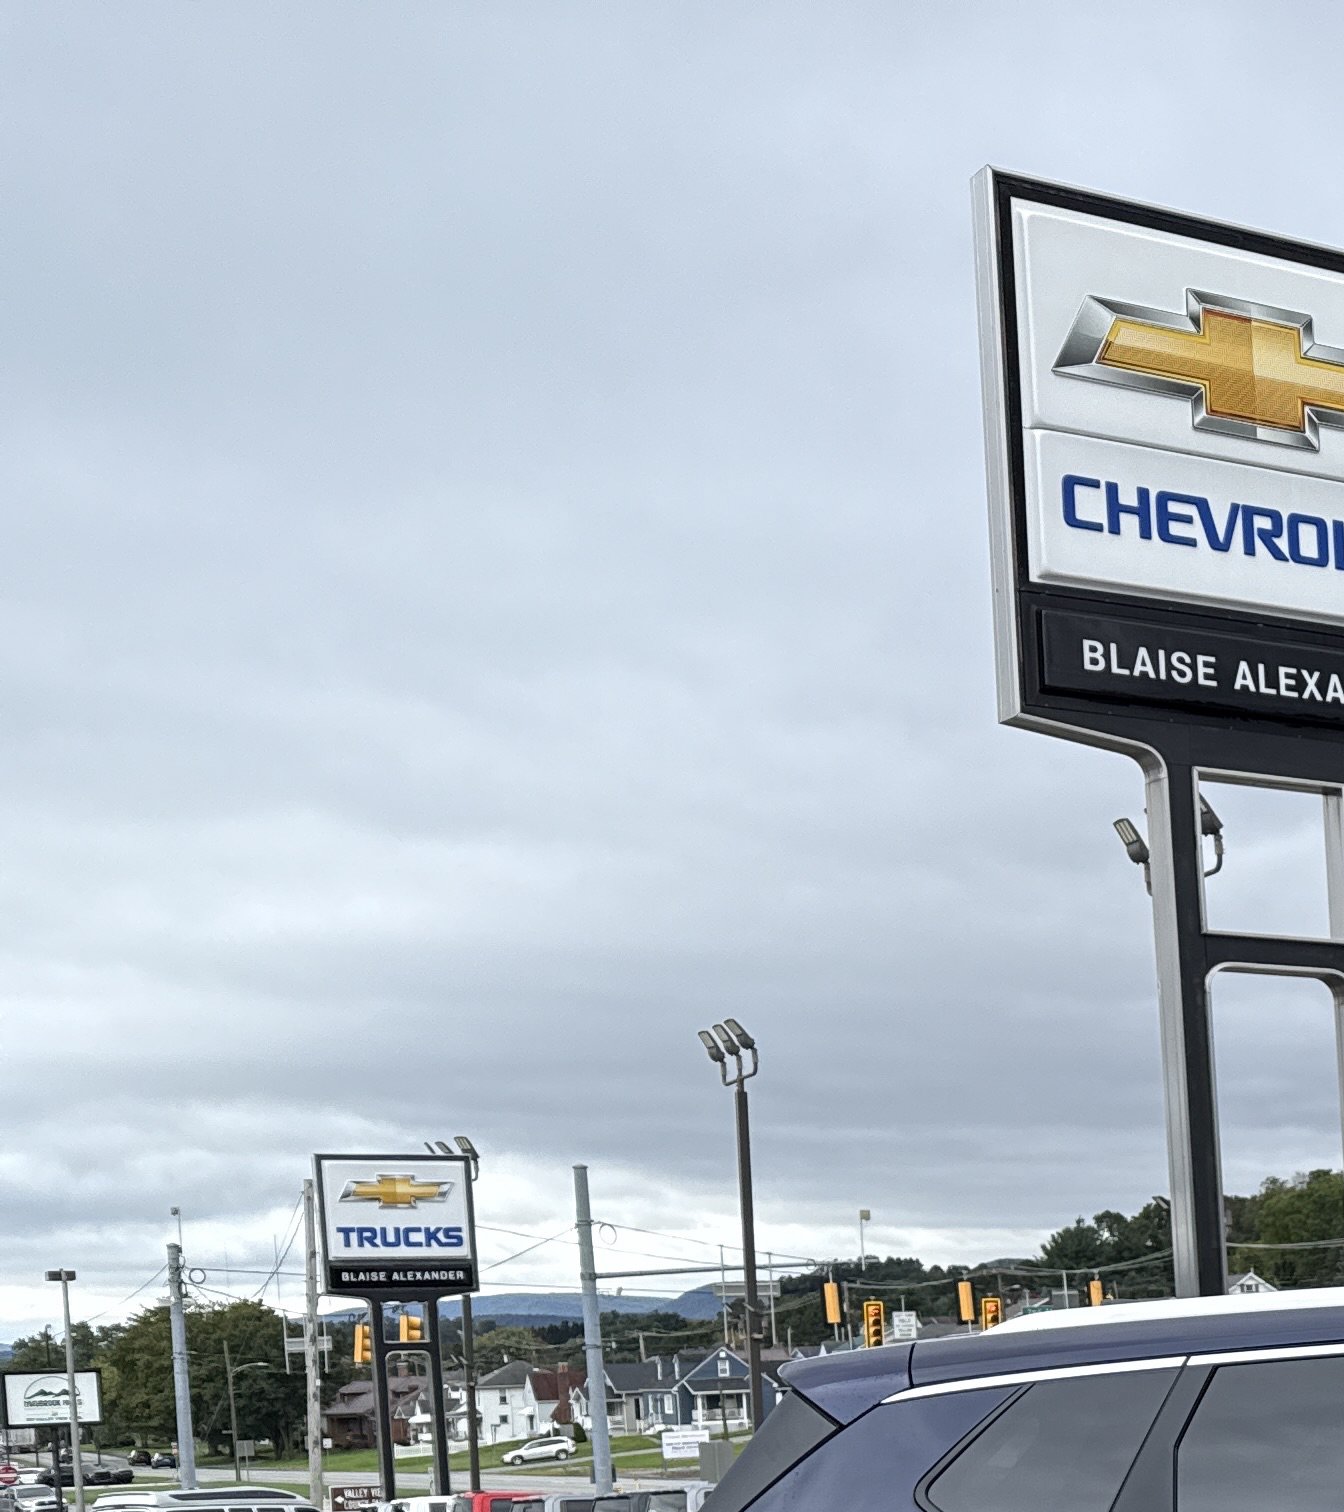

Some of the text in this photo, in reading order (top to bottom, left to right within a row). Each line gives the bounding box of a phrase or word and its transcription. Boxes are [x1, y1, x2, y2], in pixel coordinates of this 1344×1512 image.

[1082, 639, 1218, 687] BLAISE
[336, 1226, 464, 1248] TRUCKS
[341, 1270, 465, 1282] BLAISE ALEXANDER
